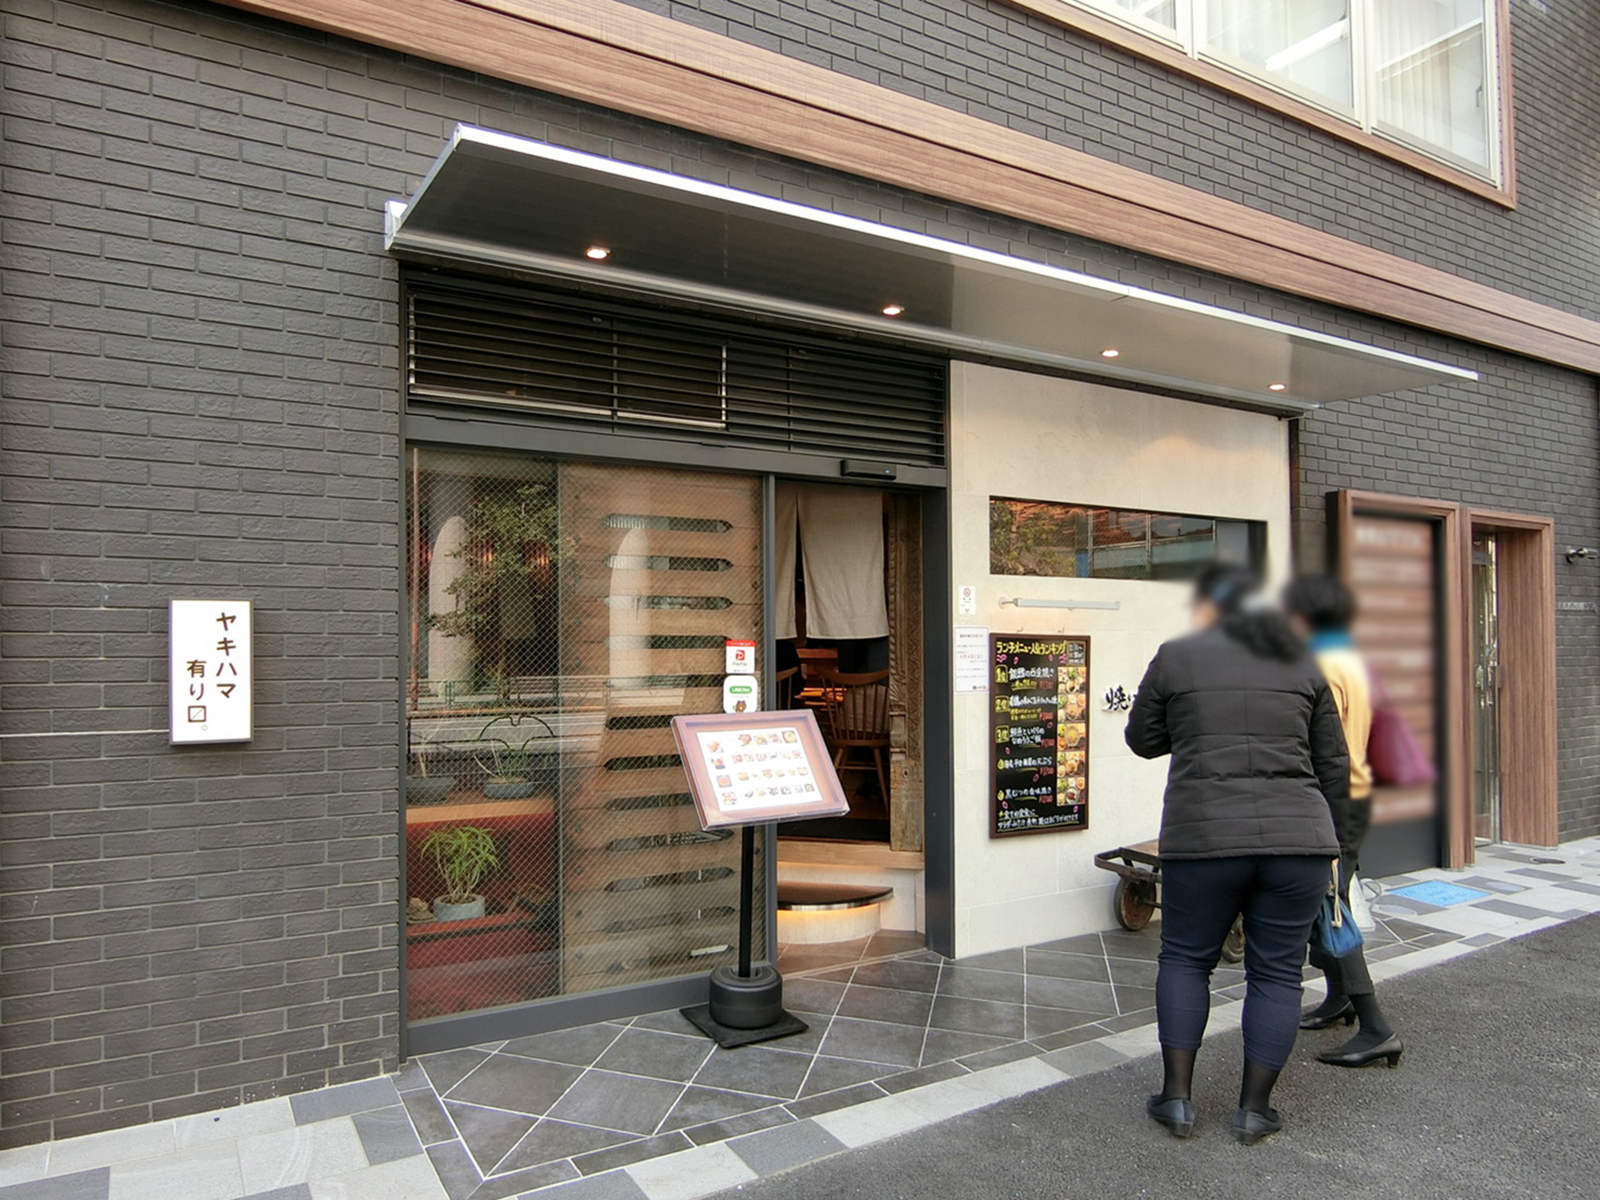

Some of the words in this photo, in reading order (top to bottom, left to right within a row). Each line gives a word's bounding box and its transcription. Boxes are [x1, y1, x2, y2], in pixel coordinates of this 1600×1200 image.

[216, 612, 237, 699] ヤキハマ
[996, 729, 1009, 743] 3位
